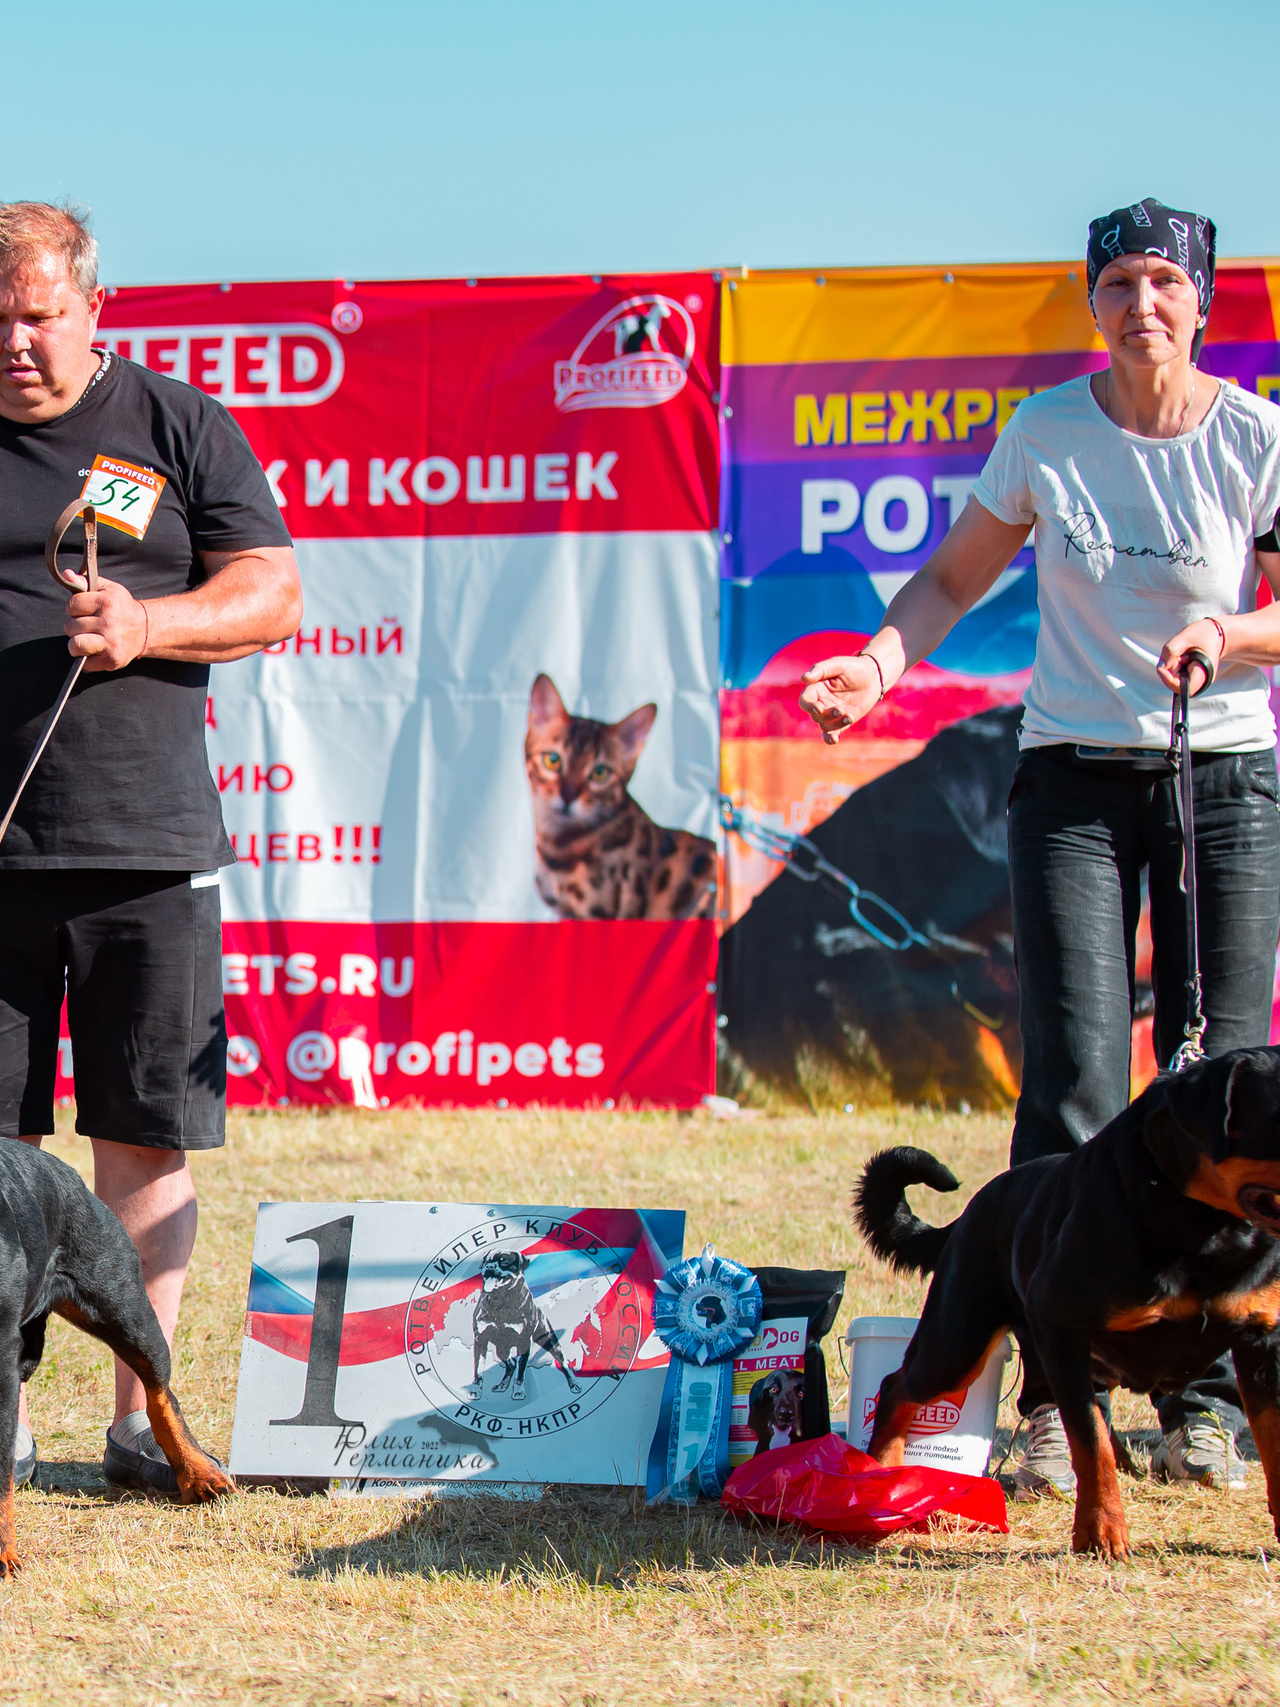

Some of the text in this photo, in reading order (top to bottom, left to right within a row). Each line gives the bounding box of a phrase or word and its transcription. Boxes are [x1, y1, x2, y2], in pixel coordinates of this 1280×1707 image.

[558, 366, 682, 387] PROFIFEED
[793, 387, 1032, 447] МЕЖРЕ
[88, 478, 140, 512] 54
[101, 460, 156, 487] PROFIFEED
[305, 458, 349, 507] И
[368, 450, 620, 507] КОШЕК
[800, 474, 980, 556] РОТ
[1063, 511, 1209, 568] Remember
[269, 1215, 365, 1426] 1
[409, 1219, 639, 1383] РОТВЕЙЛЕР КЛУБ РОССИИ
[755, 1356, 800, 1370] MEAT
[454, 1402, 582, 1436] РКФ-НКПР
[684, 1382, 713, 1432] OPEN
[932, 1445, 959, 1454] подход
